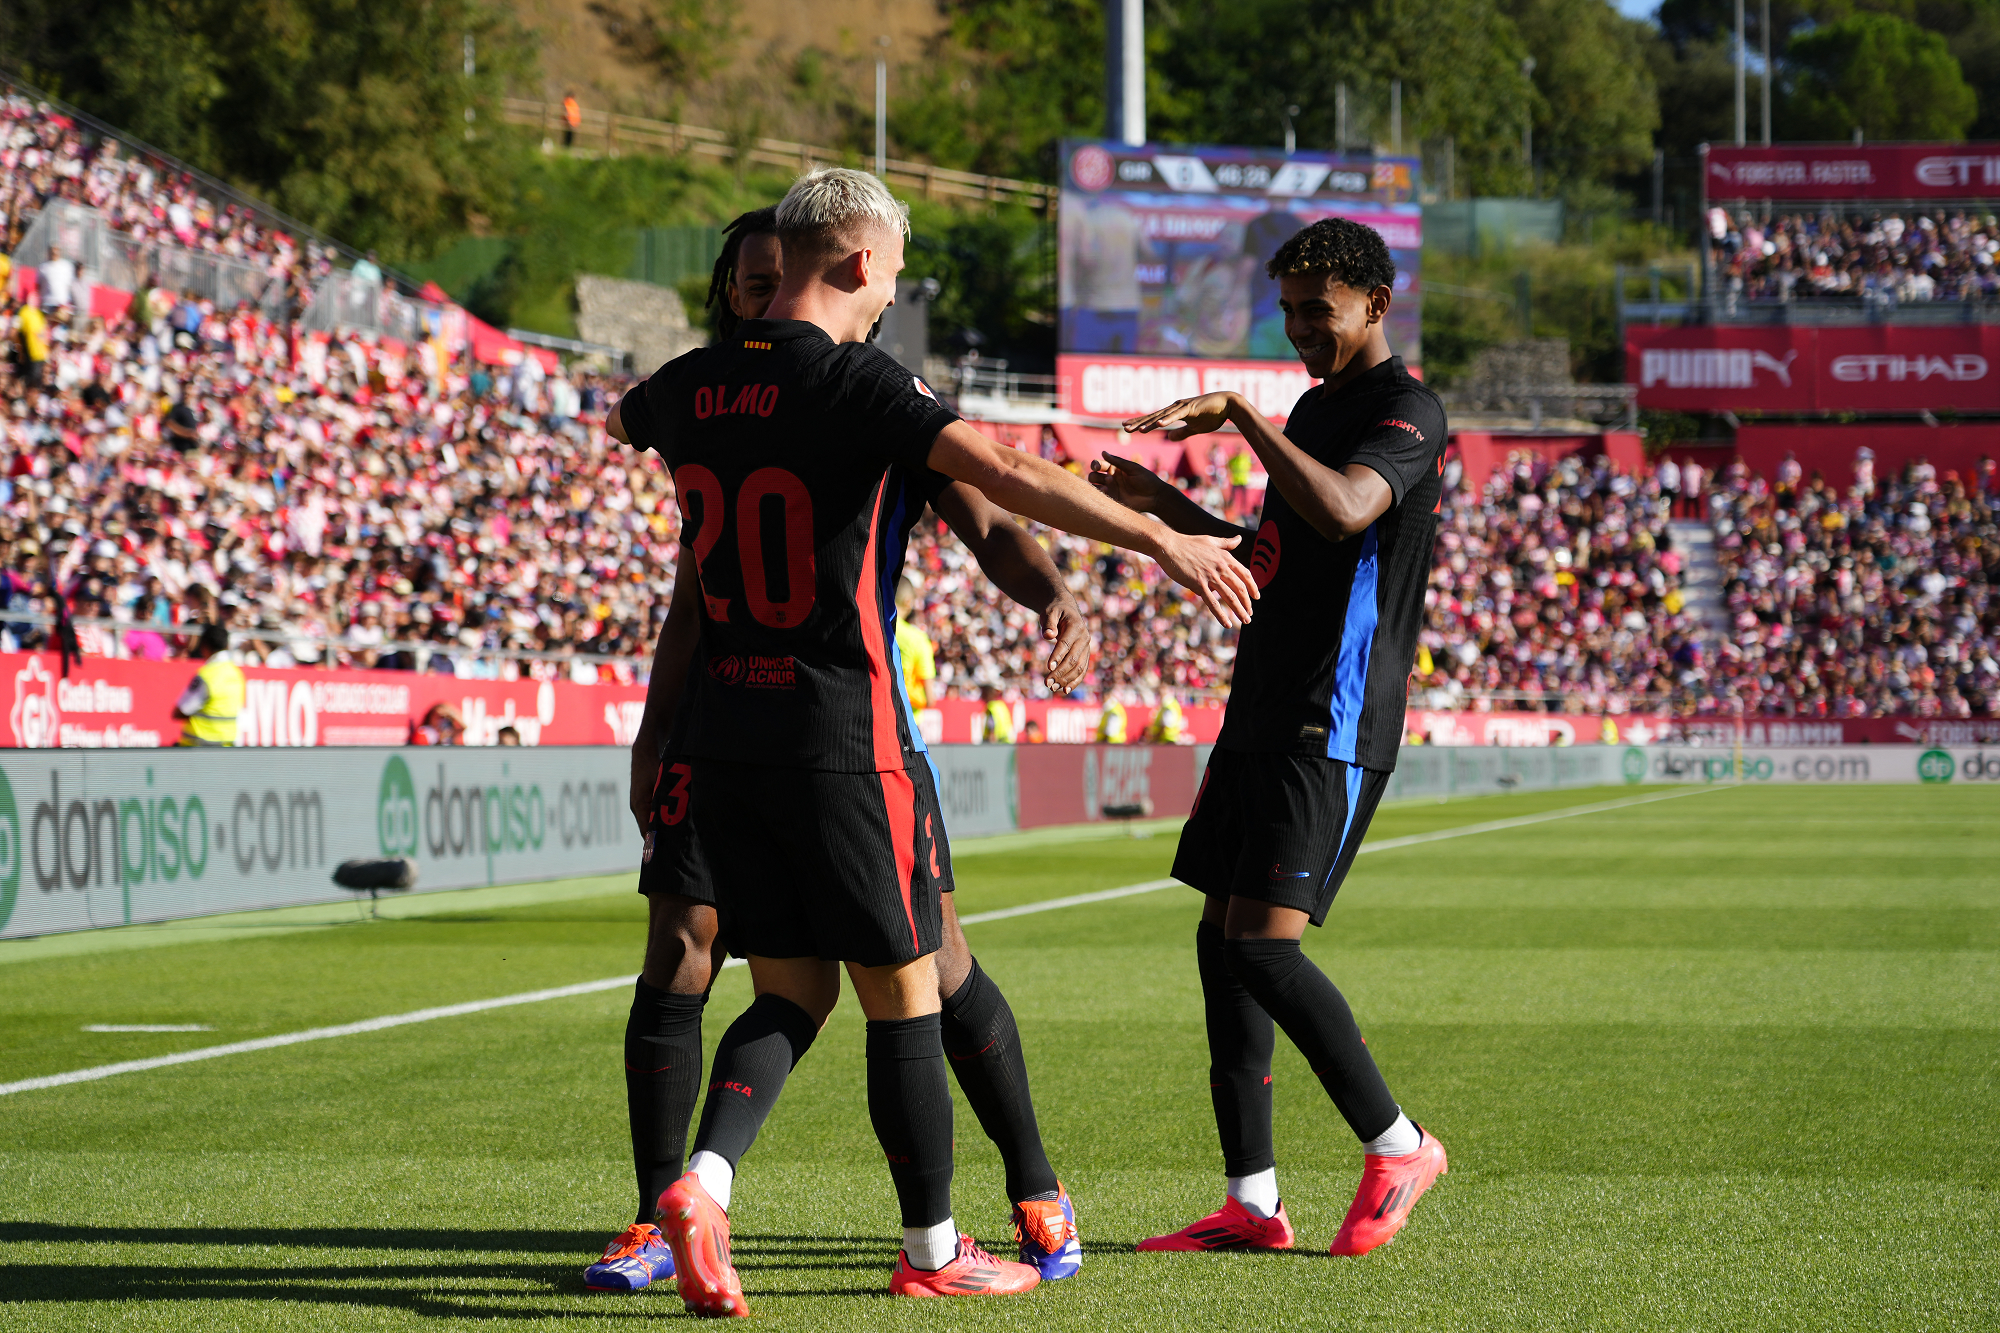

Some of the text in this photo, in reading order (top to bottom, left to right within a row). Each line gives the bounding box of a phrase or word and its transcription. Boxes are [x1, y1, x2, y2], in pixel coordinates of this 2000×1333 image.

[1641, 349, 1751, 388] PUMA
[1831, 353, 1988, 382] ETIHAD
[695, 383, 779, 420] OLMO
[1083, 364, 1201, 414] GIRONA
[674, 463, 816, 629] 20
[746, 670, 796, 684] ACNUR
[748, 656, 794, 670] UNHCR
